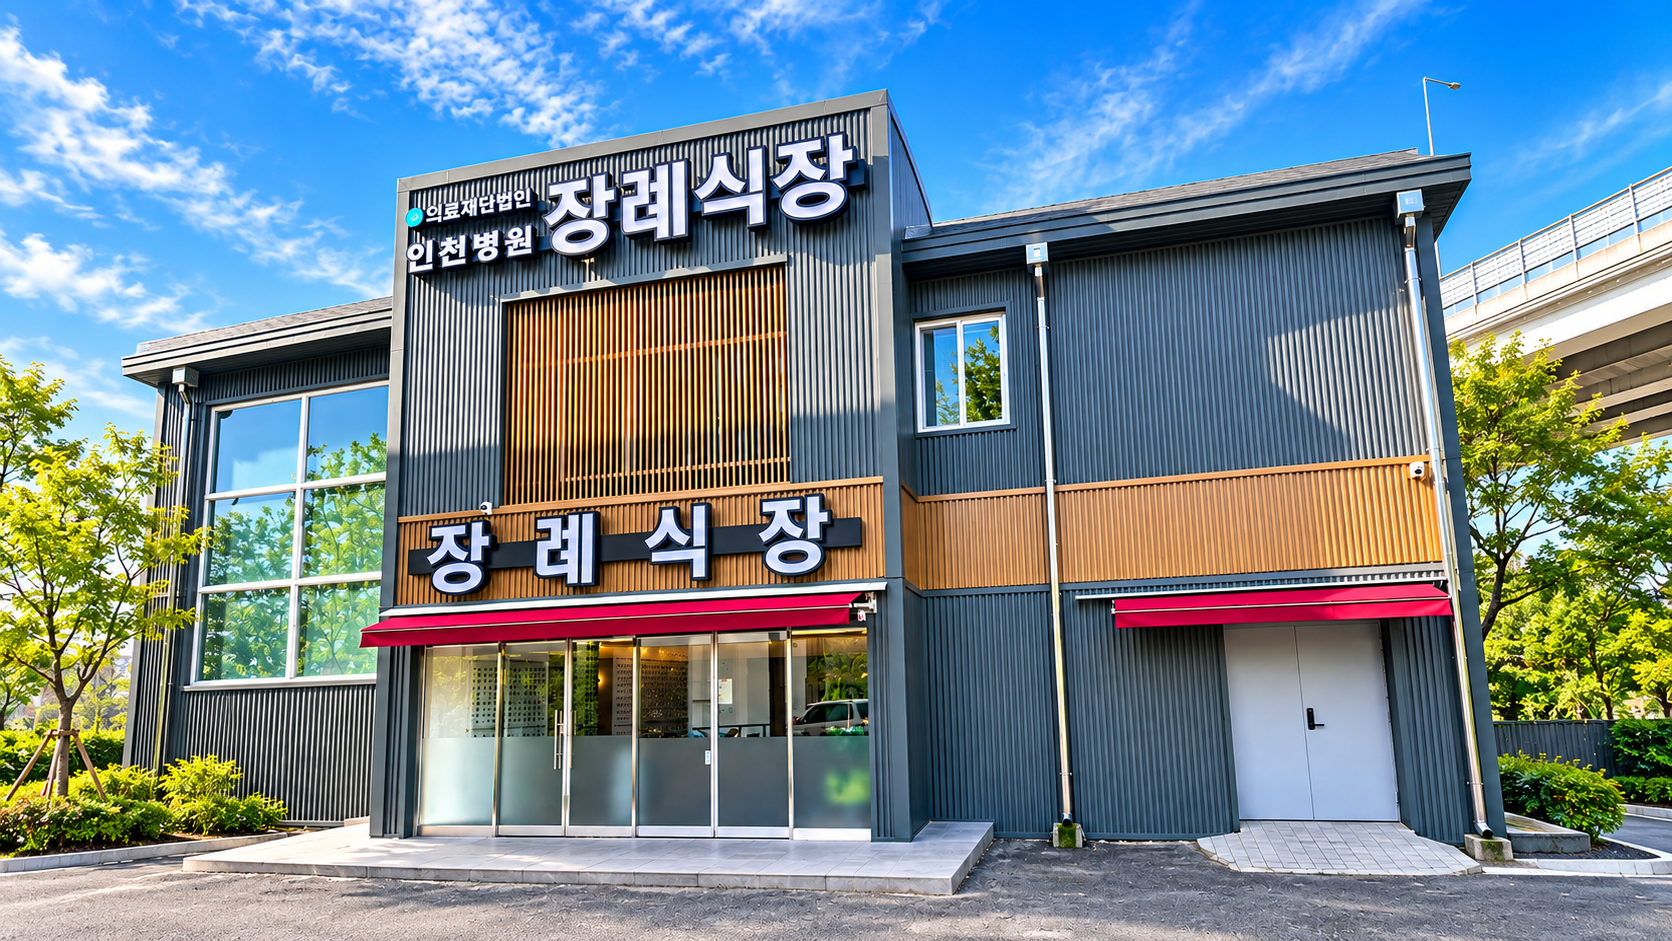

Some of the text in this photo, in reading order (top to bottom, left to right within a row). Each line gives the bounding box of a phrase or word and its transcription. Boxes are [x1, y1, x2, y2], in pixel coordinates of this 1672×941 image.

[426, 188, 532, 224] 의료재단법인
[543, 134, 856, 255] 장례식장
[406, 225, 533, 273] 인천병원
[427, 495, 830, 594] 장례식장
